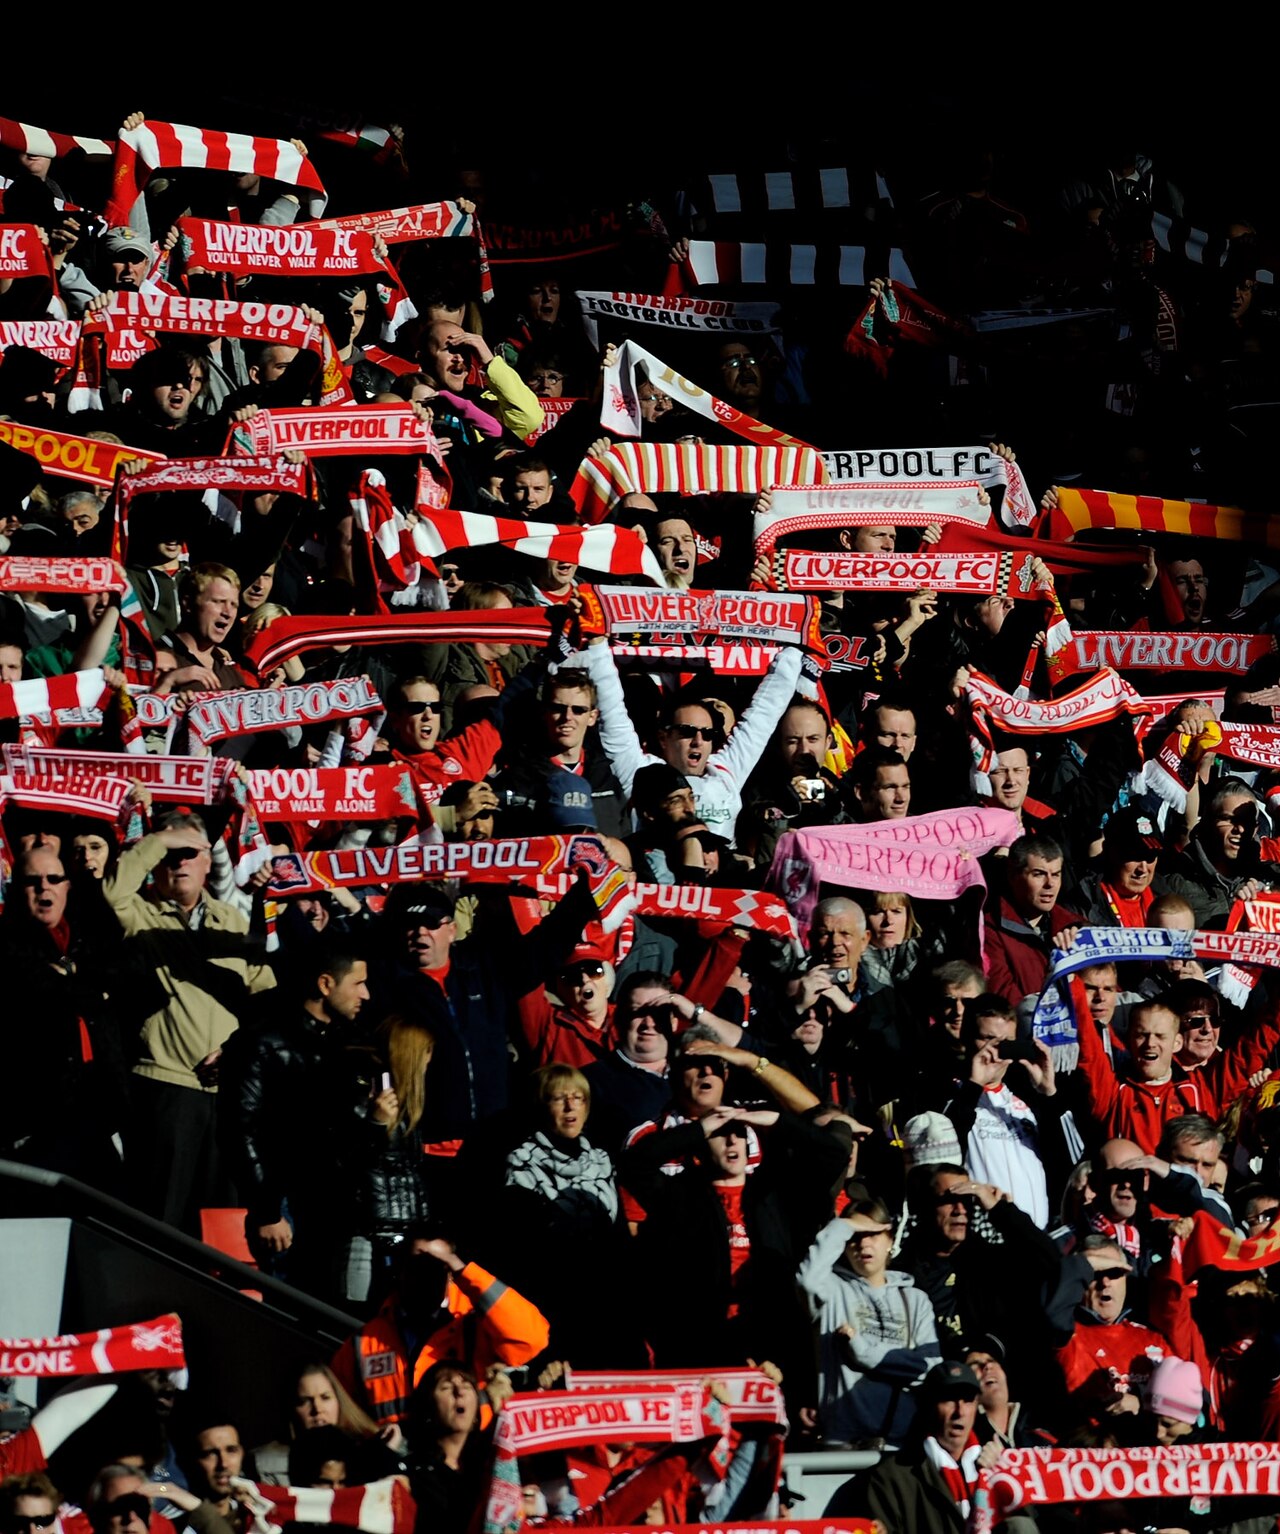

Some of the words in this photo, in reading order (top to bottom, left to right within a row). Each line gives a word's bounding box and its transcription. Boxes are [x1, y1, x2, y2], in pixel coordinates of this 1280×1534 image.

[2, 228, 26, 259] FC
[203, 222, 317, 252] LIVERPOOL
[333, 229, 357, 256] FC
[206, 251, 243, 265] YOU'LL
[247, 253, 282, 267] NEVER
[288, 255, 316, 269] WALK
[323, 256, 359, 270] ALONE
[107, 291, 309, 331] LIVERPOOL
[587, 297, 700, 328] FOOTBALL
[703, 315, 762, 331] CLUB
[612, 290, 736, 318] LIVERPOOL
[127, 315, 226, 333] FOOTBALL
[242, 324, 290, 340] CLUB
[274, 419, 388, 443] LIVERPOOL
[398, 418, 426, 438] FC
[953, 451, 992, 476] FC
[807, 491, 924, 510] LIVERPOOL
[791, 557, 945, 580] LIVERPOOL
[955, 560, 993, 580] FC
[662, 623, 686, 631] HOPE
[748, 627, 776, 637] HEART
[1075, 636, 1256, 670] LIVERPOOL
[187, 678, 382, 741] LIVERPOOL
[175, 764, 204, 785] FC
[345, 768, 376, 799] FC
[256, 801, 281, 813] VER
[290, 800, 326, 813] WALK
[334, 800, 376, 813] ALONE
[563, 792, 588, 807] GAP
[328, 840, 540, 880] LIVERPOOL
[800, 832, 971, 881] LIVERPOOL
[1095, 929, 1165, 947] PORTO
[1085, 945, 1143, 957] 08-03-01
[369, 1355, 392, 1375] 251
[743, 1381, 775, 1402] FC
[642, 1400, 670, 1420] FC
[1061, 1458, 1280, 1503] LIVERPOOL
